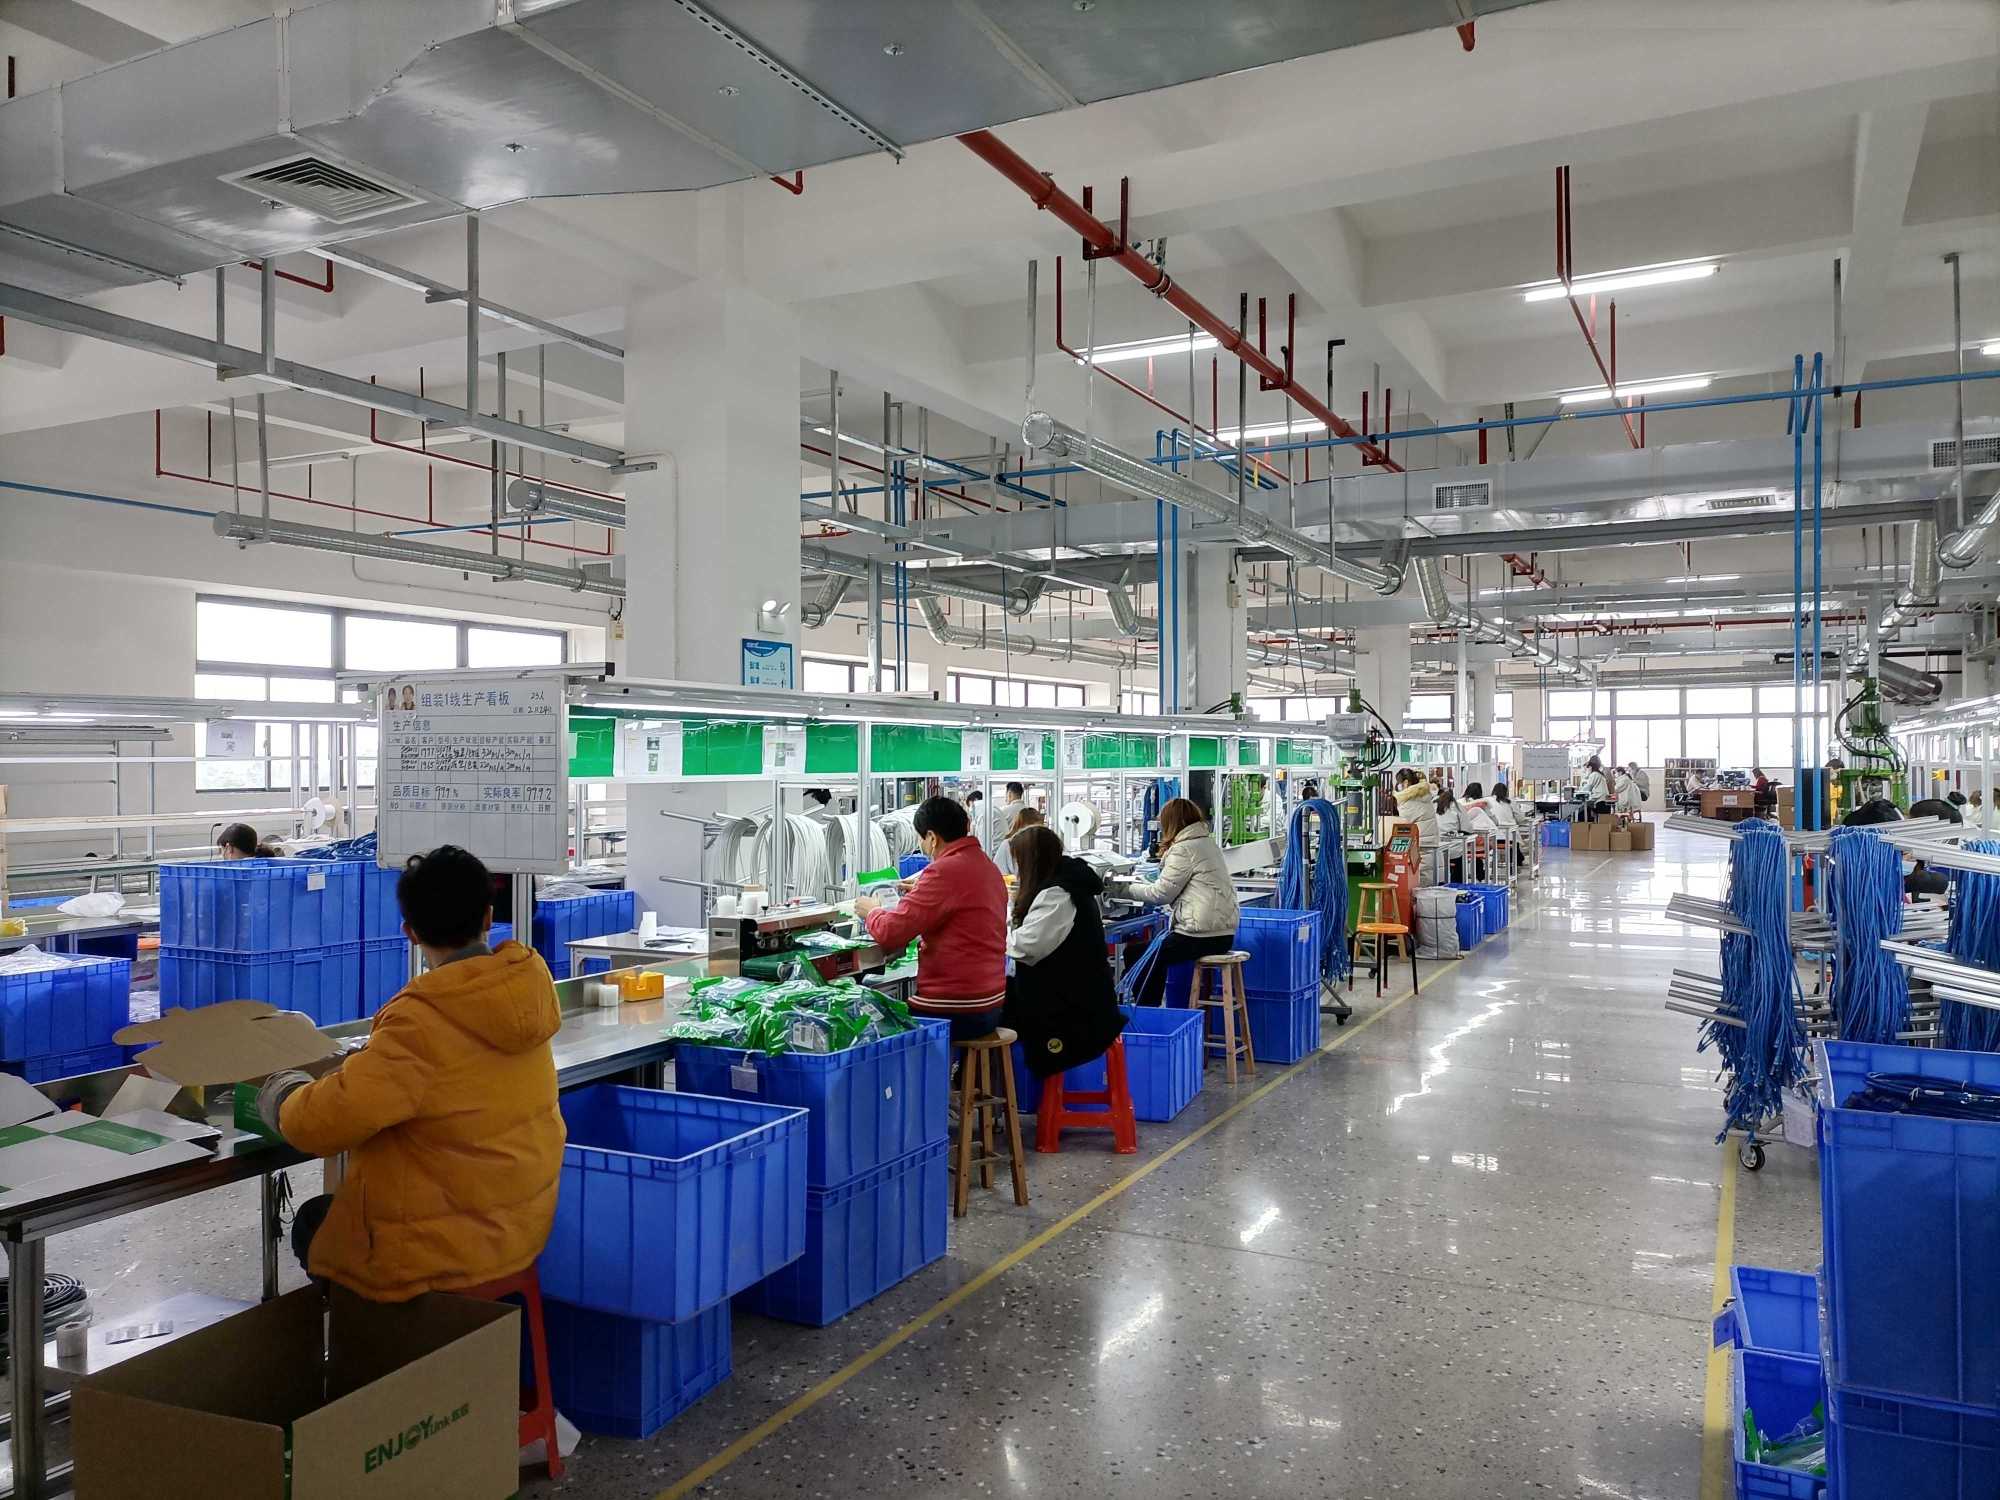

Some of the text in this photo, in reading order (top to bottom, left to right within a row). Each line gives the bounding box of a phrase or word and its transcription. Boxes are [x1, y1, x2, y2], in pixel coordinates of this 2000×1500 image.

[421, 690, 511, 707] 组装1线生产看板
[393, 719, 431, 731] 生产信息
[393, 785, 430, 797] 品质目标
